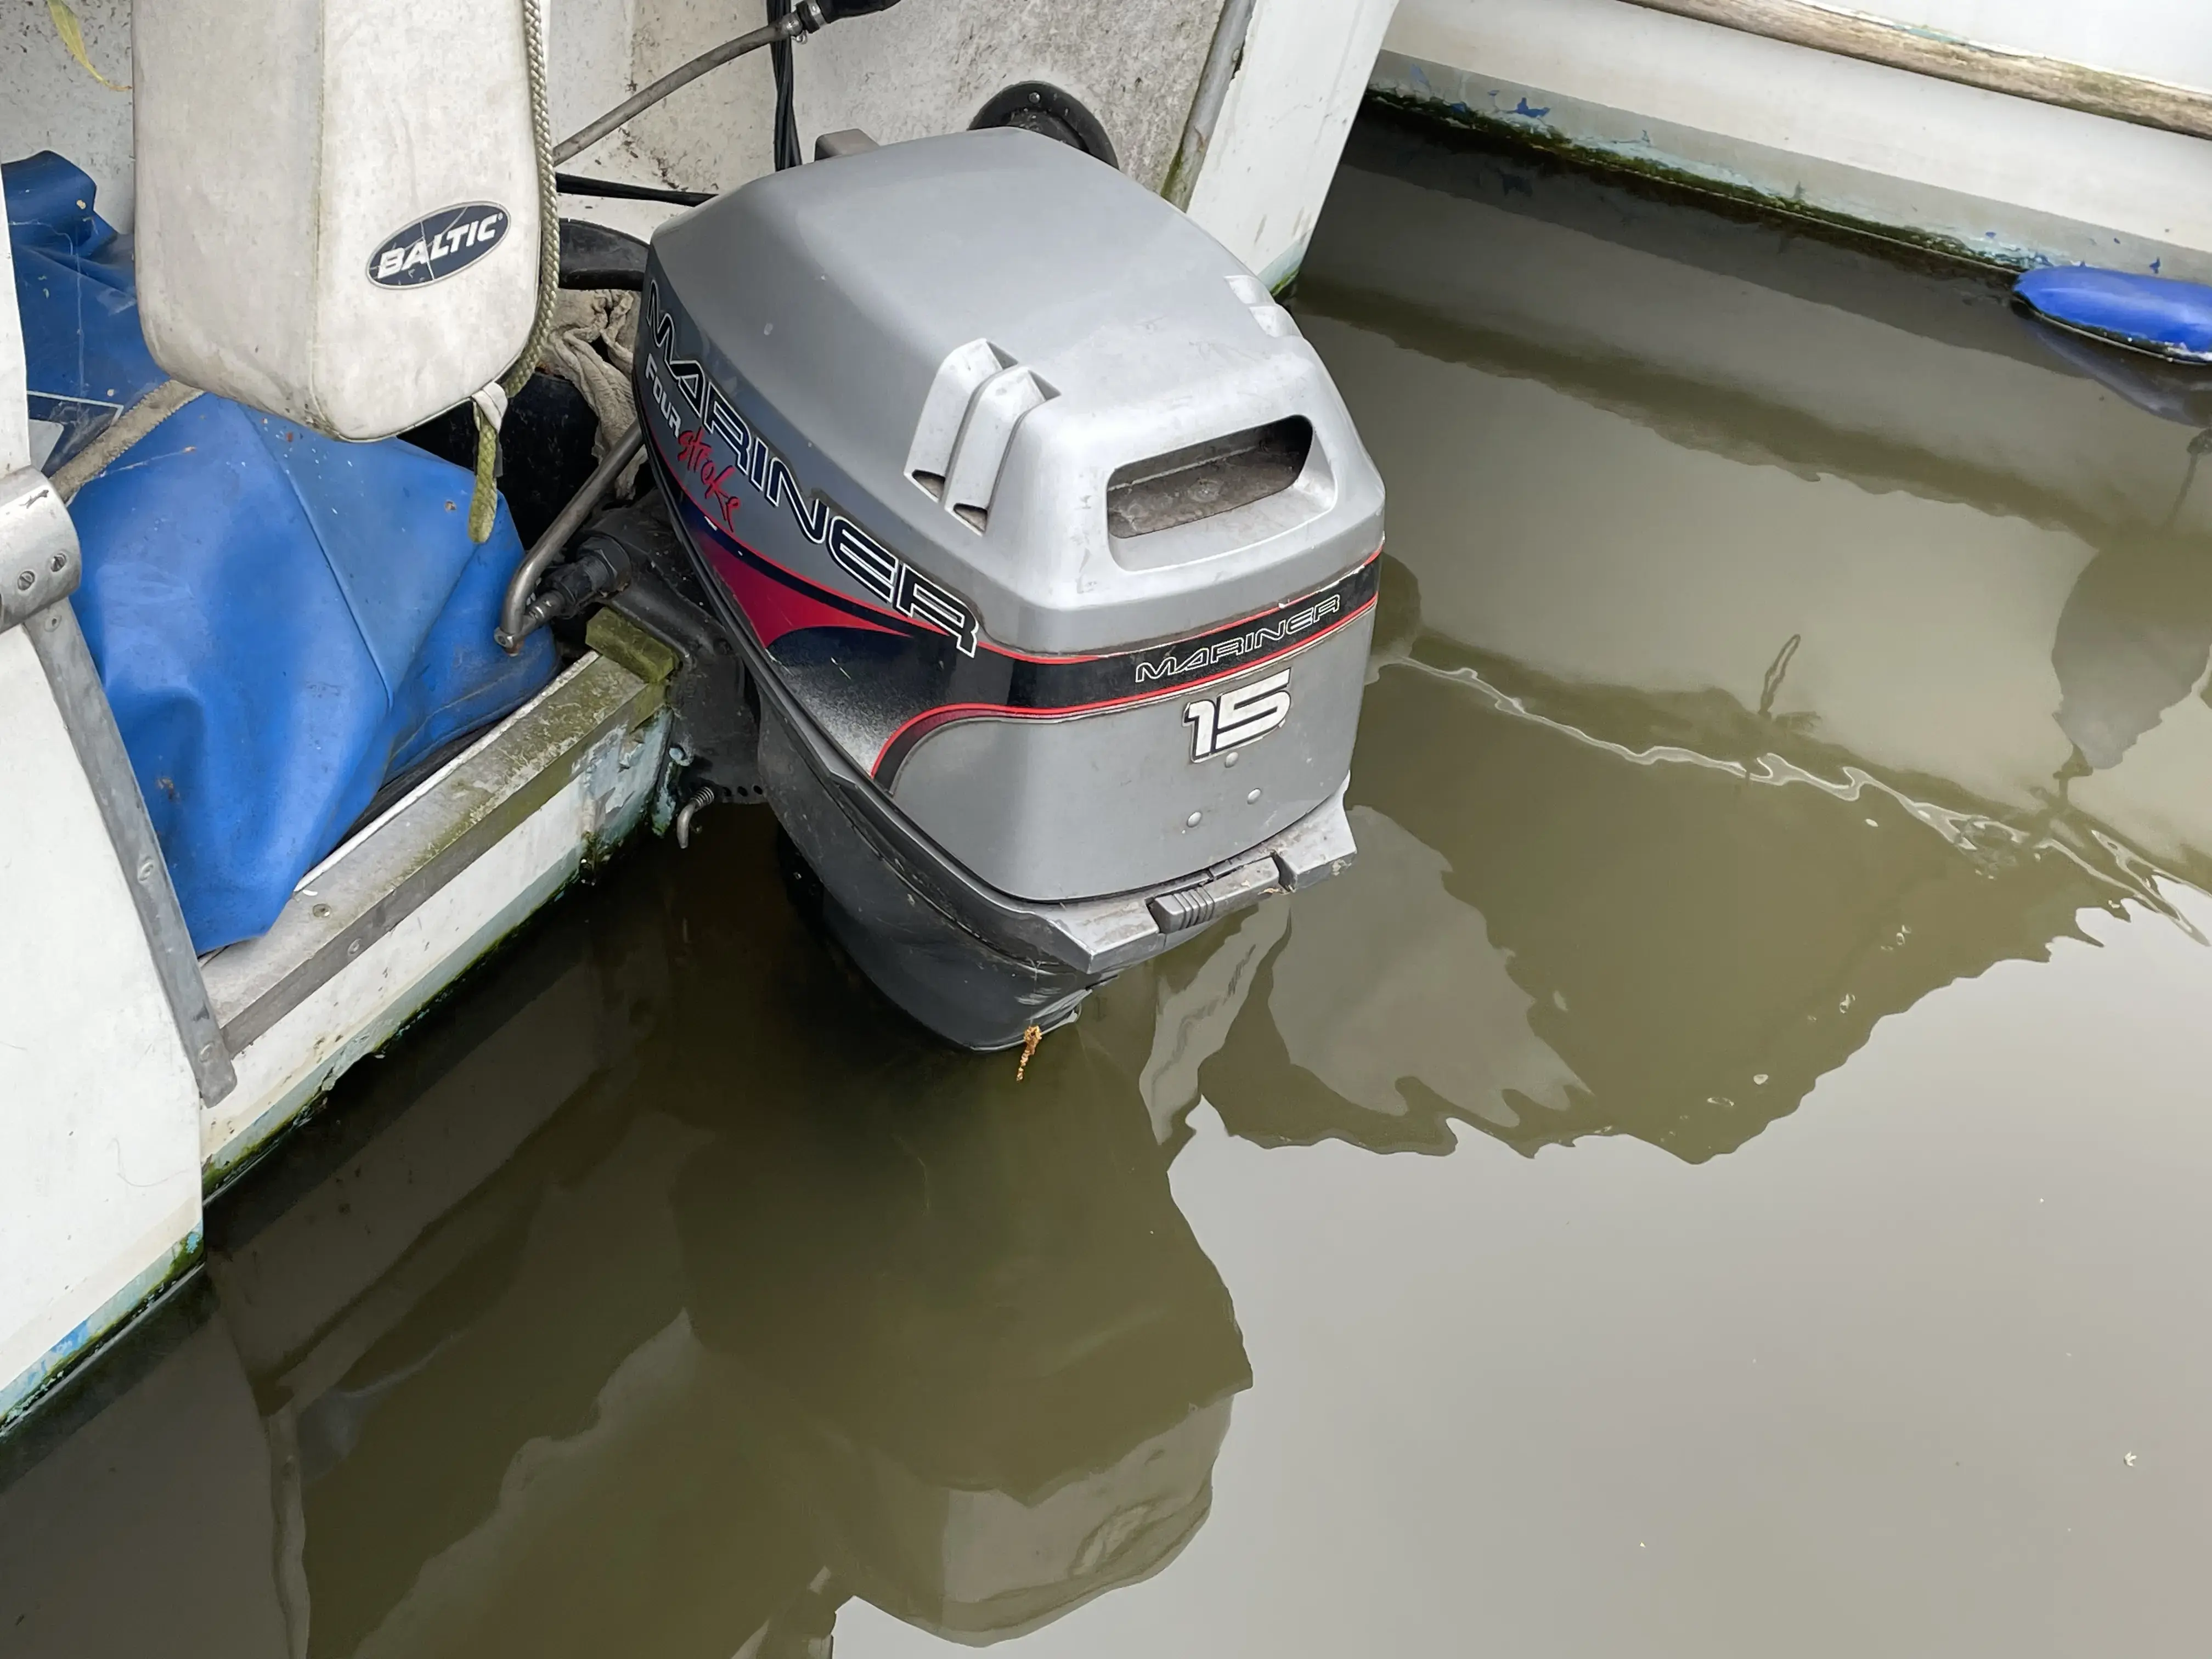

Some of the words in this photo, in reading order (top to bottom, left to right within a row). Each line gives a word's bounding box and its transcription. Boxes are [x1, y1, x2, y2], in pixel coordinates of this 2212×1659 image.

[378, 212, 499, 279] BALTIC
[645, 353, 682, 438] FOUR
[646, 279, 979, 658] MARINER
[1135, 594, 1340, 682] MARINER
[1183, 667, 1291, 763] 15
